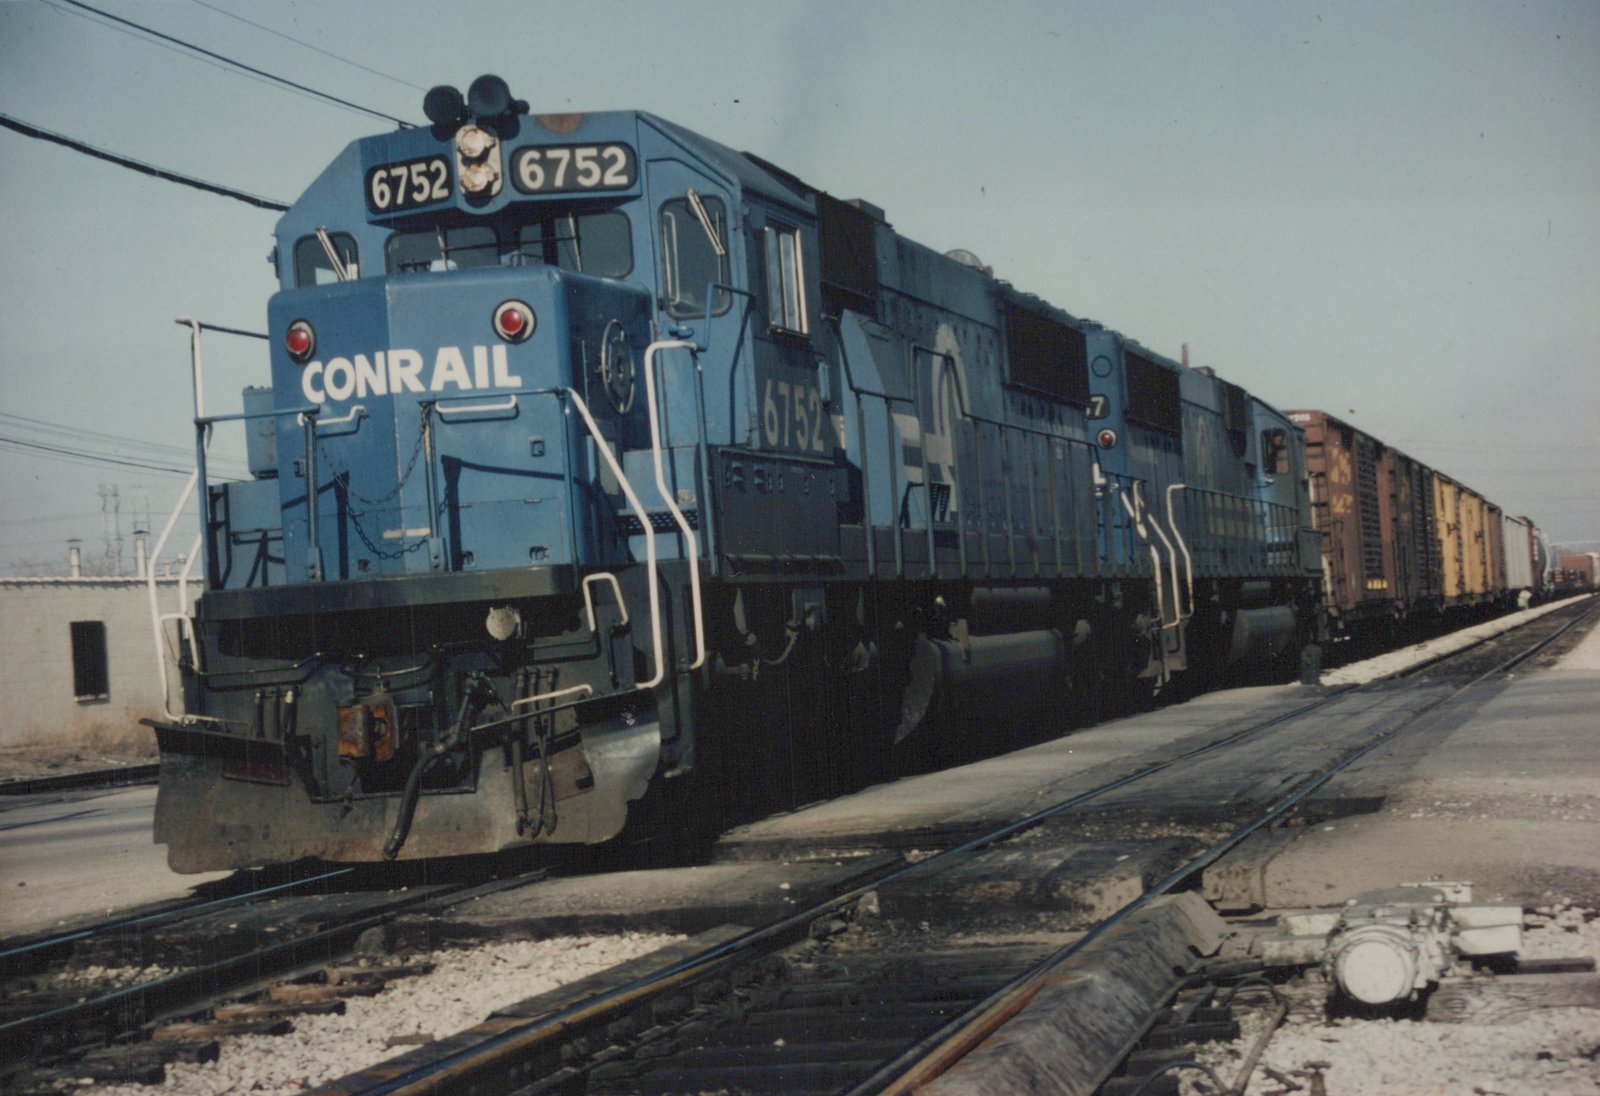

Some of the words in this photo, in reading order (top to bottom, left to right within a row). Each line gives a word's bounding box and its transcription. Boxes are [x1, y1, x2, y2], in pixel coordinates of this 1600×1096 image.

[371, 160, 449, 209] 6752
[518, 146, 628, 189] 6752
[301, 344, 522, 402] CONRAIL
[763, 378, 825, 452] 6752
